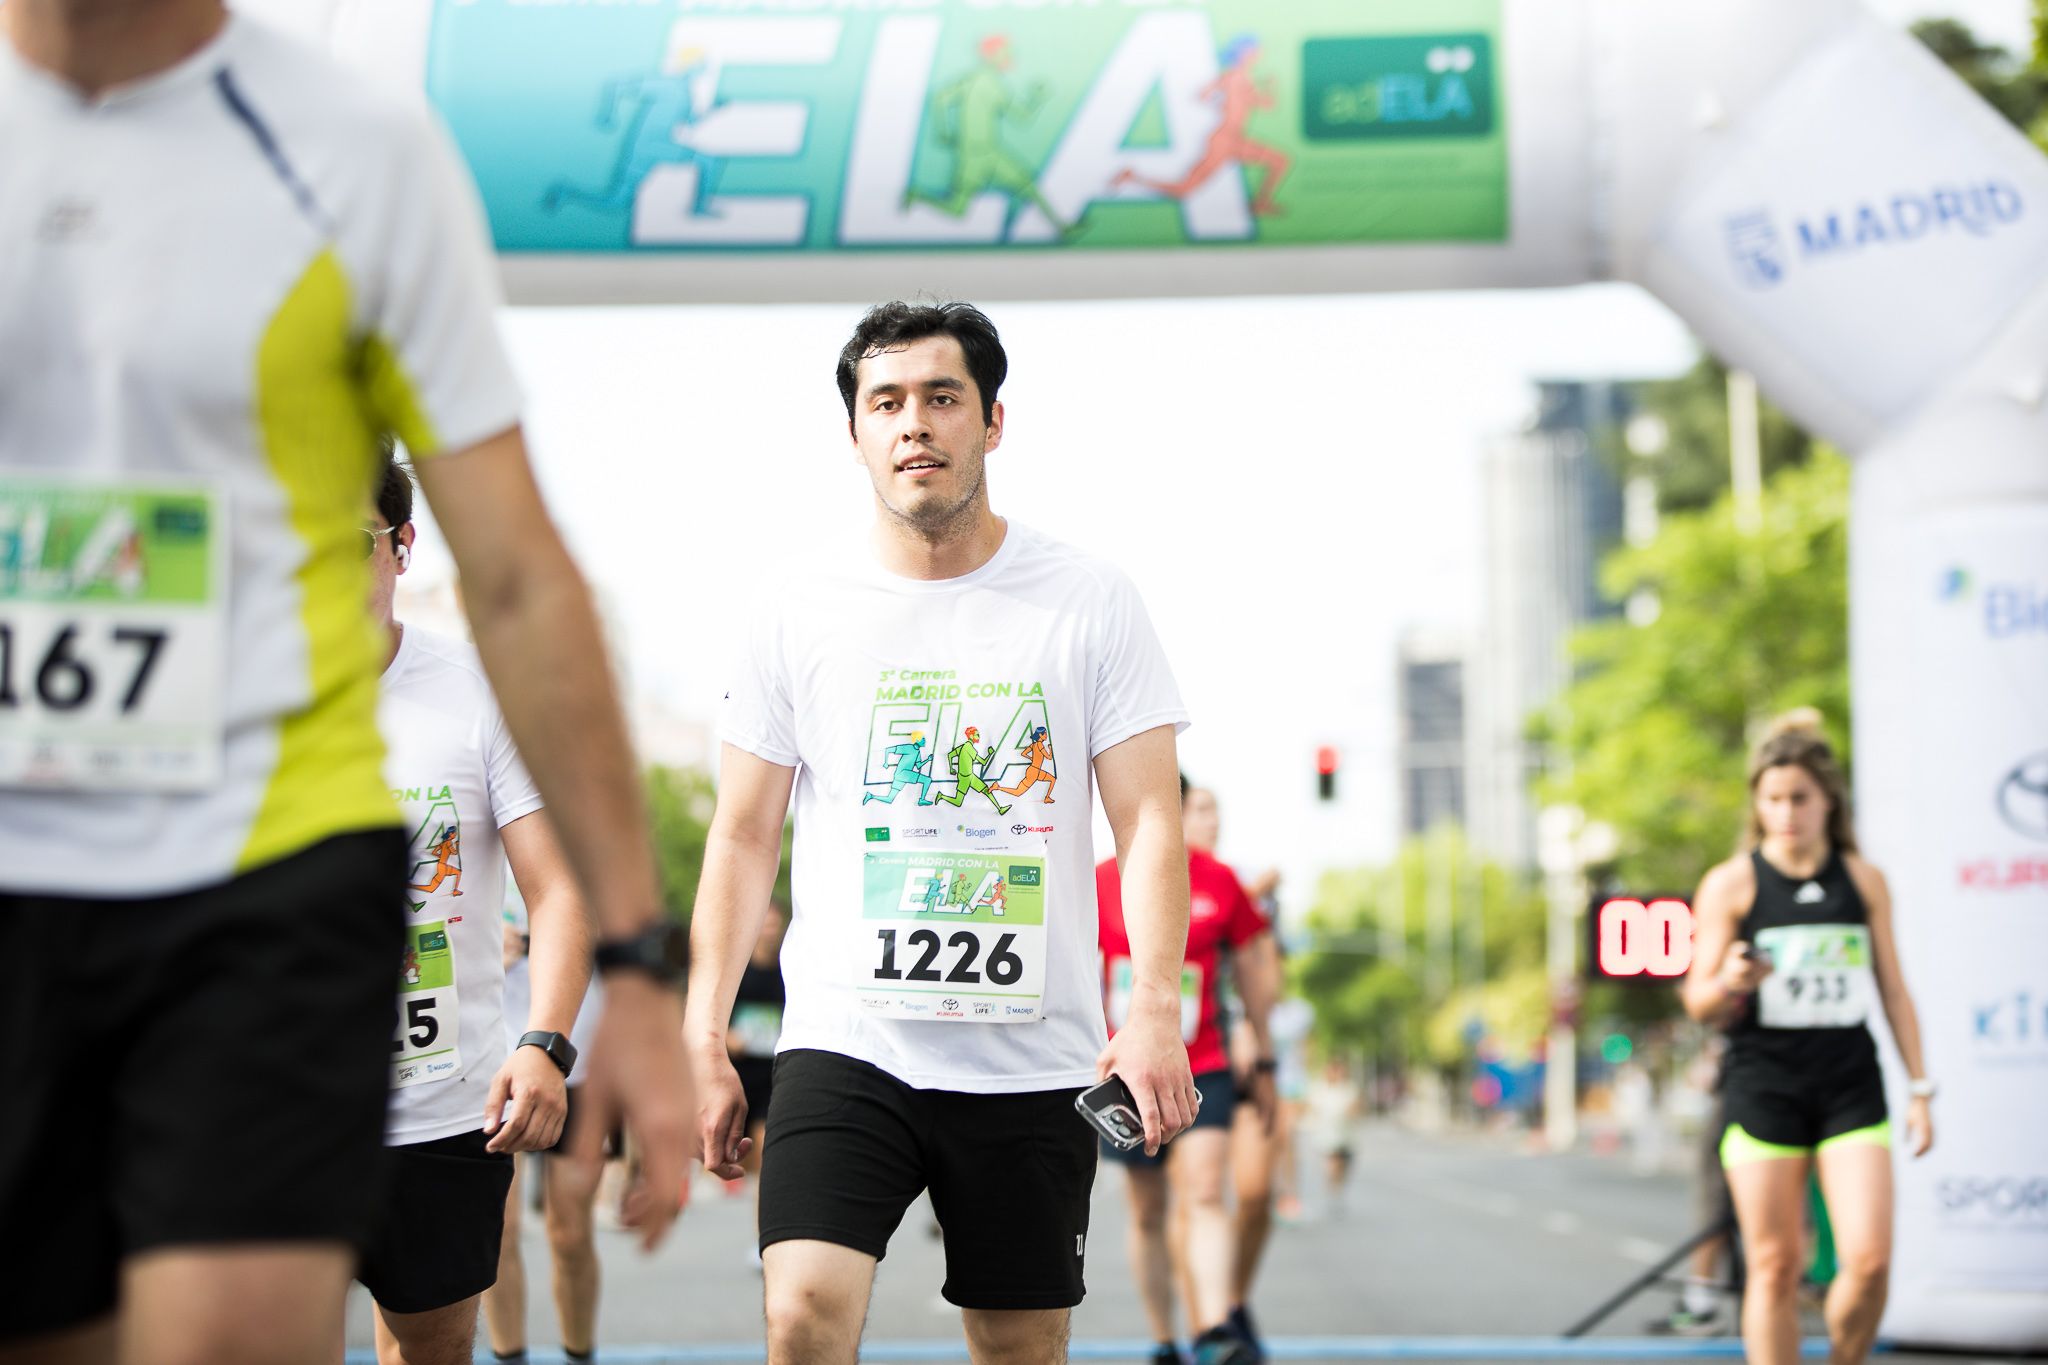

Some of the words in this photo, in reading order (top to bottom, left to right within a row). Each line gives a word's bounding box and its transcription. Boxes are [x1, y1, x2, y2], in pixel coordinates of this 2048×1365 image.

[630, 14, 1257, 246] ELA
[1796, 183, 2024, 258] MADRID
[0, 498, 144, 594] LA
[875, 684, 961, 701] MADRID
[966, 682, 1012, 698] CON
[1017, 682, 1044, 697] LA
[899, 669, 957, 681] Carrera
[863, 699, 1058, 786] ELA
[427, 784, 453, 801] LA
[965, 827, 996, 839] Biogen
[907, 857, 954, 867] MADRID
[957, 858, 983, 868] CON
[984, 860, 999, 869] LA
[1012, 874, 1037, 883] adELA
[897, 867, 1005, 916] ELA
[1598, 897, 1695, 977] 00
[874, 929, 1024, 986] 1226
[1784, 973, 1849, 1004] 933
